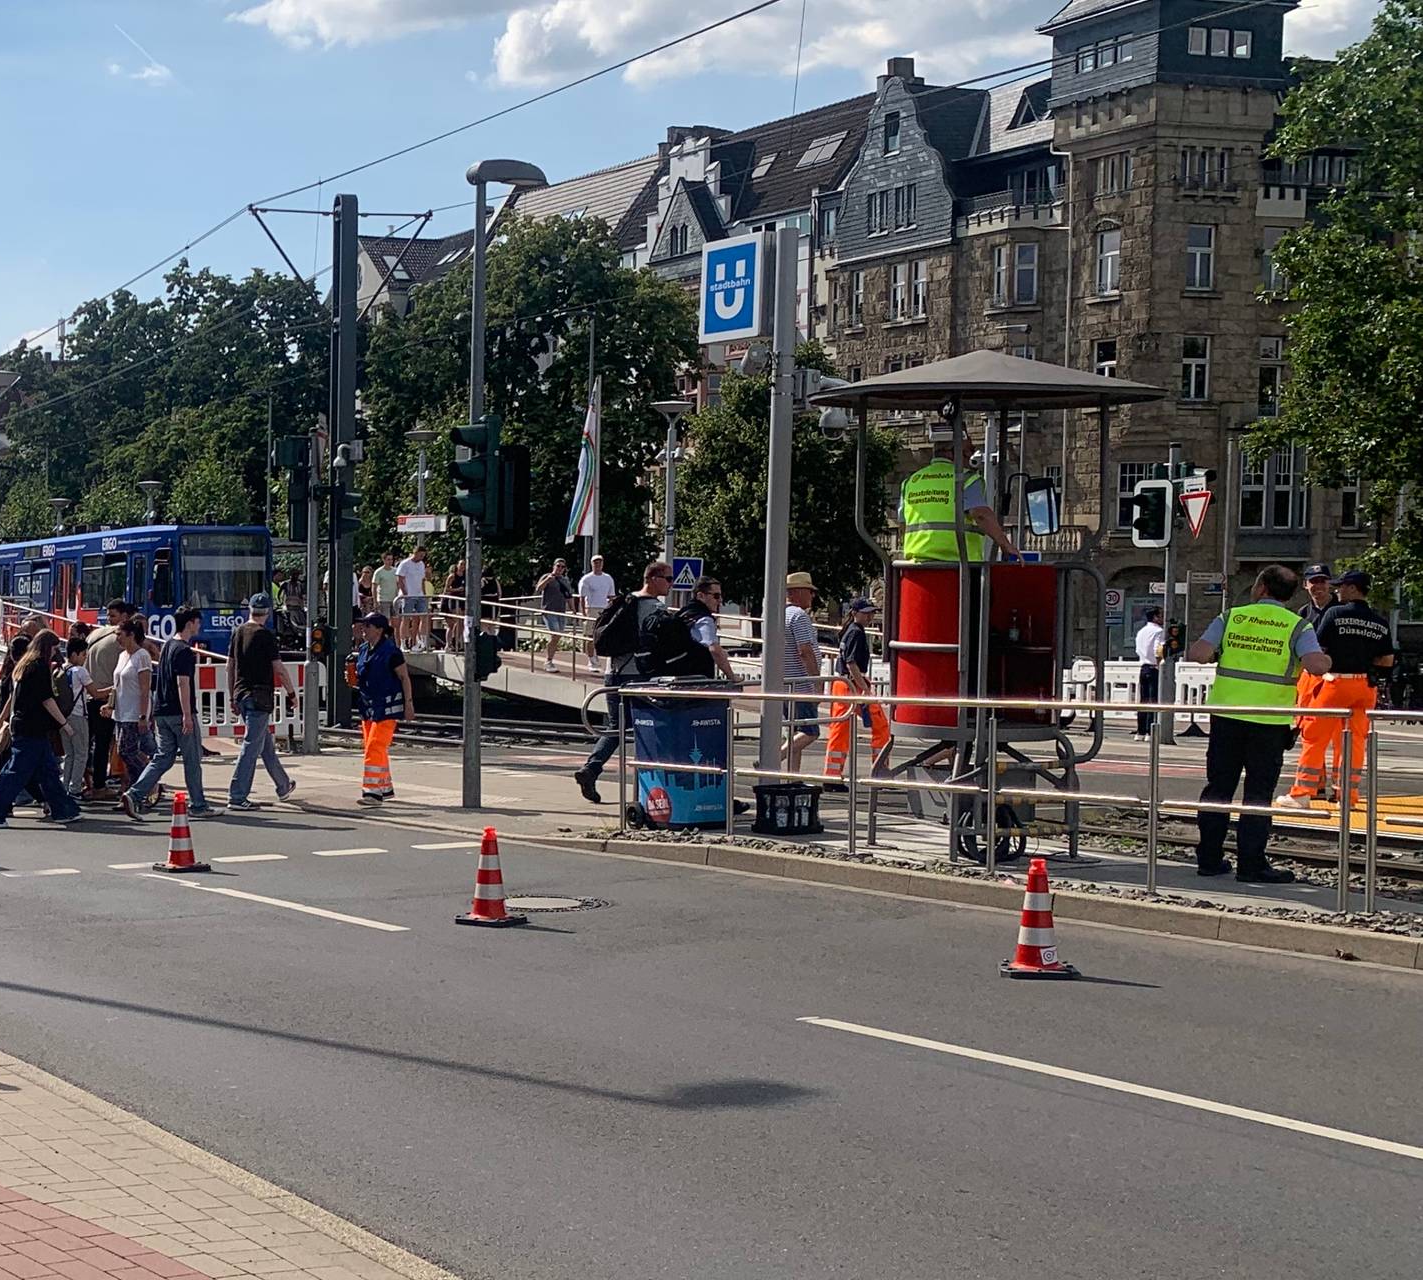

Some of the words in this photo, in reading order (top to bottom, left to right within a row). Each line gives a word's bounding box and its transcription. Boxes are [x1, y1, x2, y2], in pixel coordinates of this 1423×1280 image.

[709, 277, 751, 292] stadtbahn
[102, 536, 117, 550] ERGO
[42, 544, 56, 557] ERGO
[1107, 594, 1117, 602] 30
[211, 615, 245, 627] ERGO
[1248, 616, 1289, 628] Rheinbahn
[1228, 632, 1284, 648] Einsatzleitung
[1338, 626, 1383, 640] Düsseldorf
[1227, 640, 1283, 656] Veranstaltung
